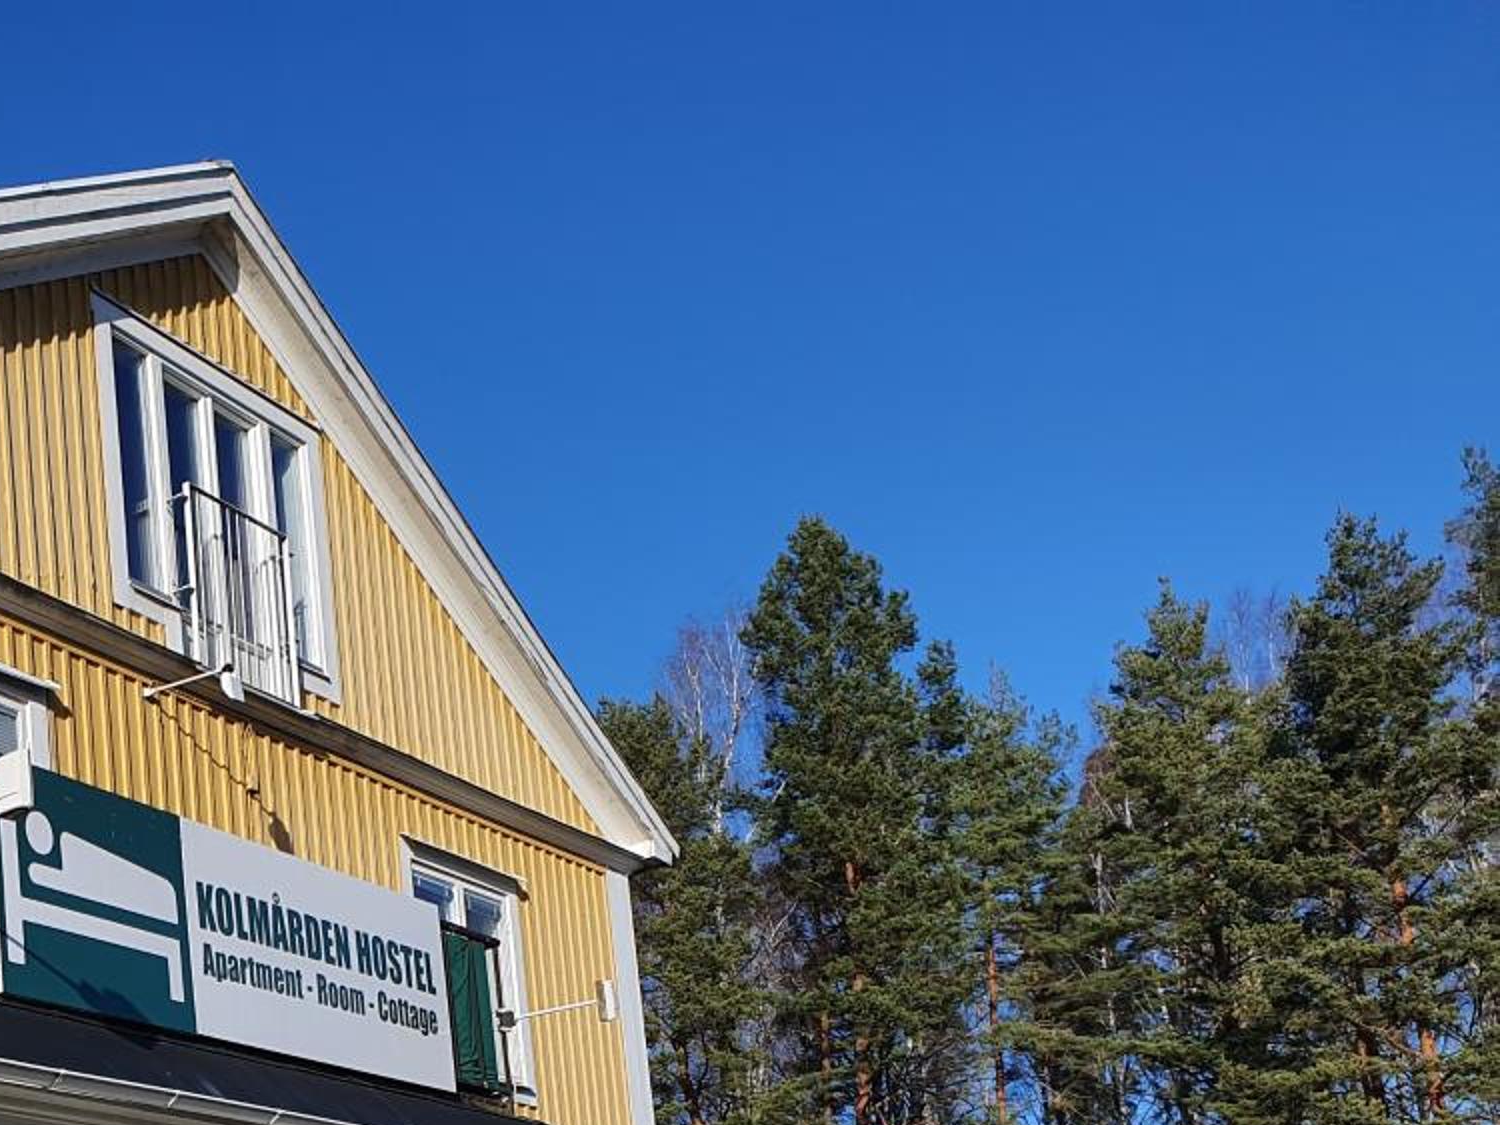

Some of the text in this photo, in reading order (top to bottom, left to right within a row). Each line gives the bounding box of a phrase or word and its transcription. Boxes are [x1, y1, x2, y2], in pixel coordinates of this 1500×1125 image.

[195, 881, 437, 995] KOLMÅRDEN HOSTEL
[203, 943, 304, 999] Apartment
[316, 973, 366, 1016] Room
[377, 990, 438, 1036] Cottage
